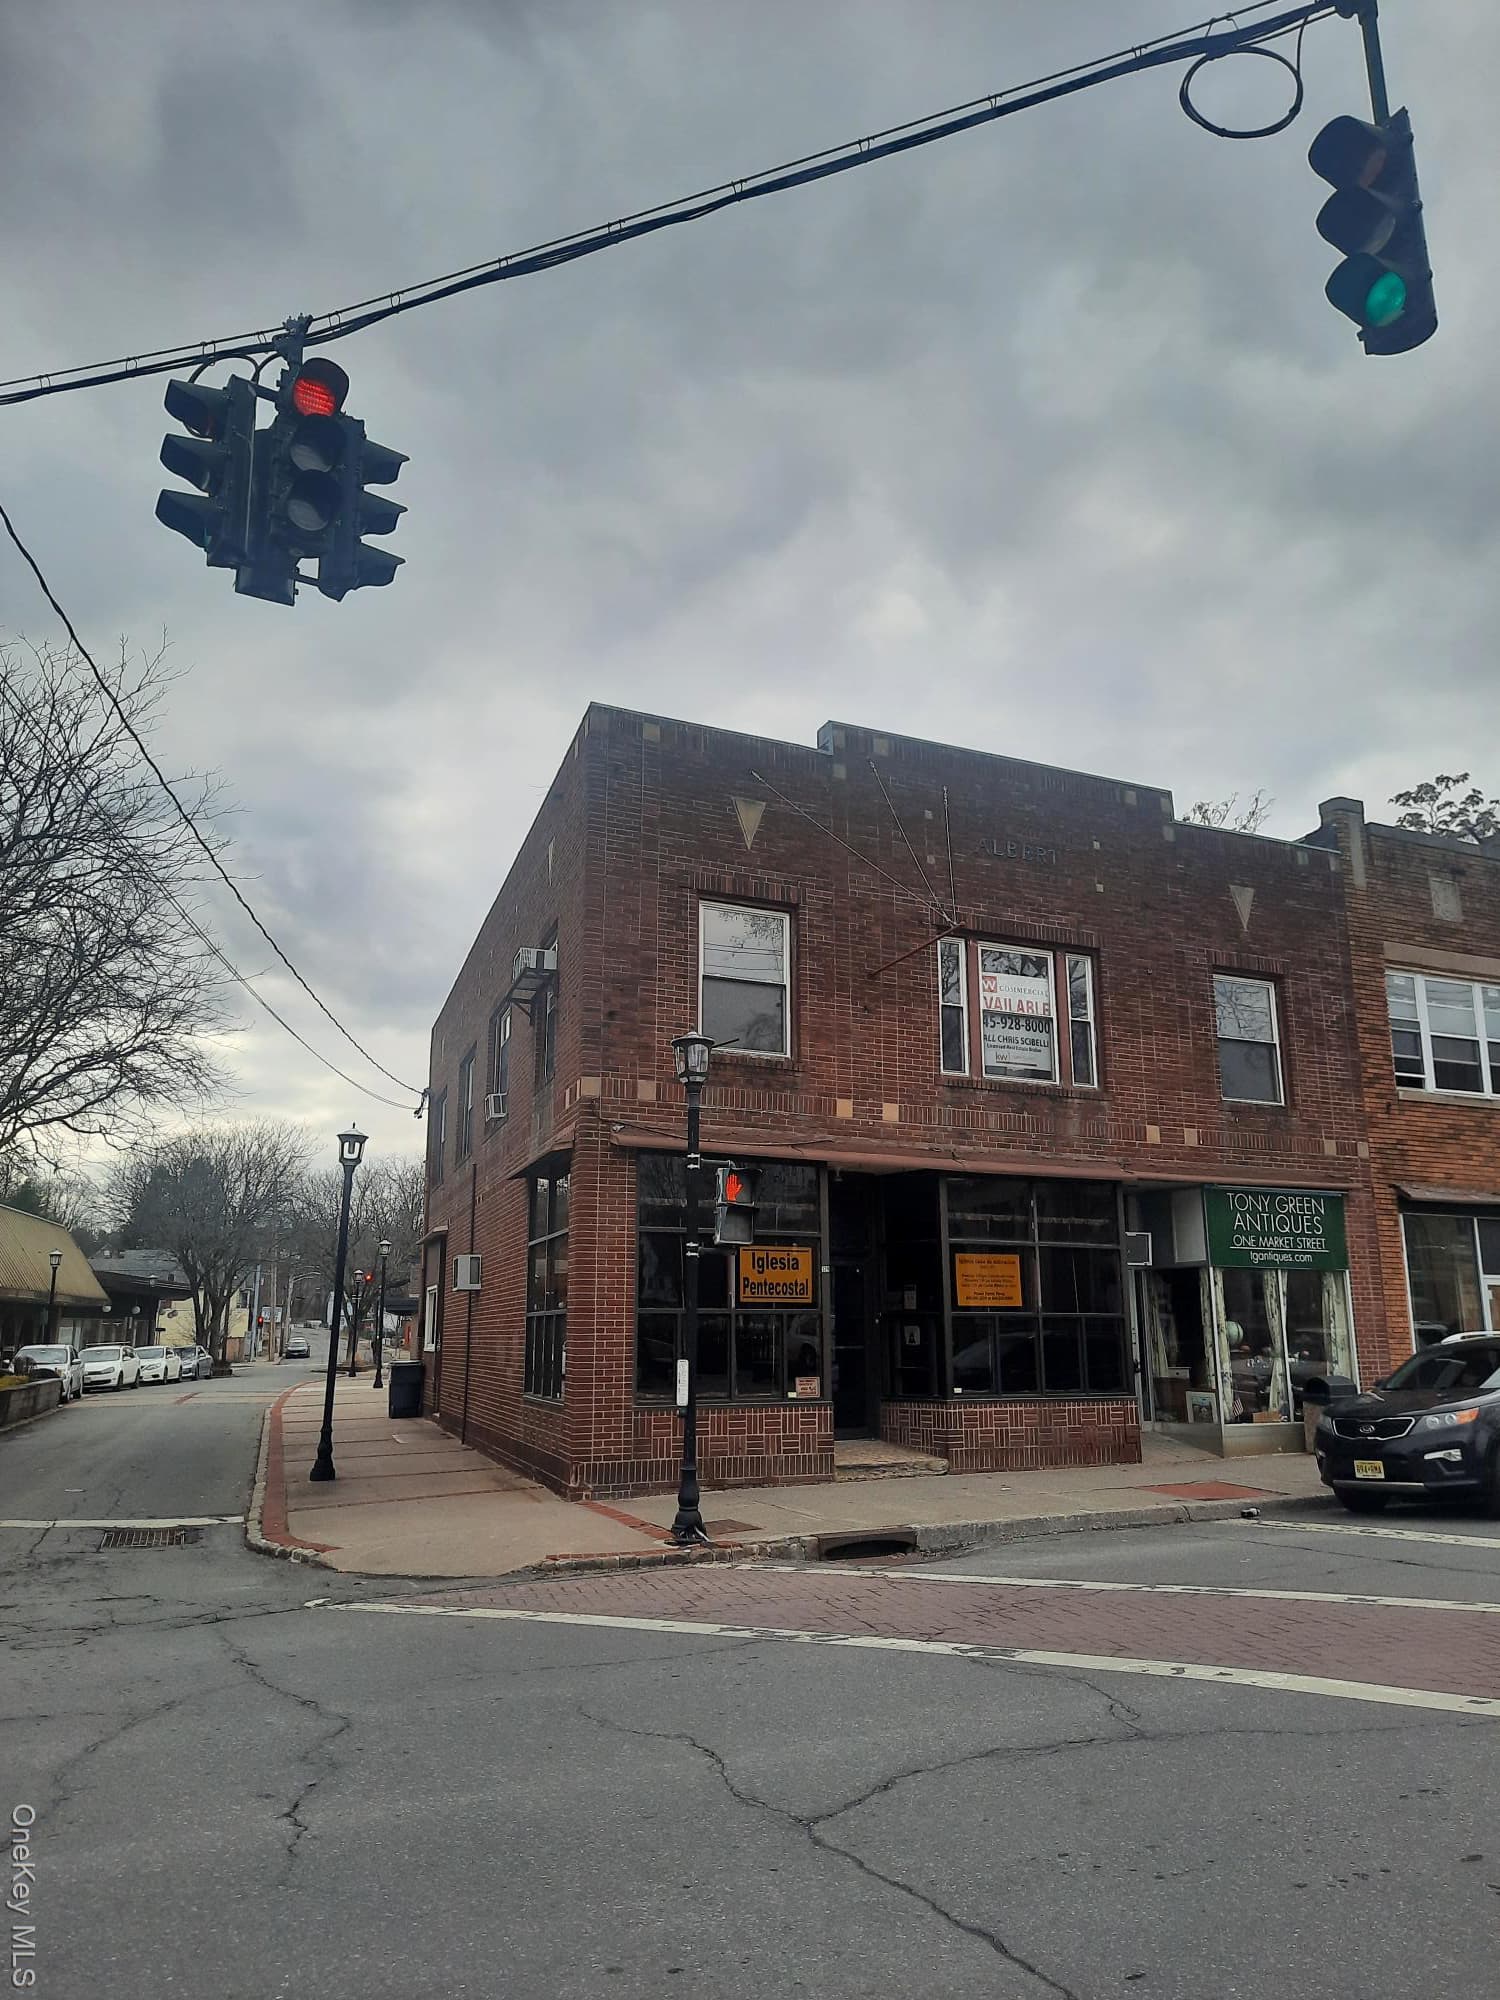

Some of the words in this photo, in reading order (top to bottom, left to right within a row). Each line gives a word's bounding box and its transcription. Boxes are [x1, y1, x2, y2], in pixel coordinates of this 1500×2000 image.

[978, 838, 1056, 865] ALBERT
[983, 995, 1050, 1015] VAILABLE
[983, 1015, 1050, 1034] 45-928-8000
[984, 1034, 995, 1042] ALL
[998, 1034, 1019, 1045] CHRIS
[1227, 1192, 1270, 1212] TONY
[1275, 1195, 1325, 1216] GREEN
[1233, 1213, 1323, 1235] ANTIQUES
[1233, 1234, 1257, 1247] ONE
[1259, 1236, 1294, 1249] MARKET
[1296, 1238, 1326, 1250] STREET
[751, 1251, 799, 1274] Iglesia
[1250, 1251, 1313, 1264] tgantiques.com
[742, 1276, 808, 1296] Pentecostal
